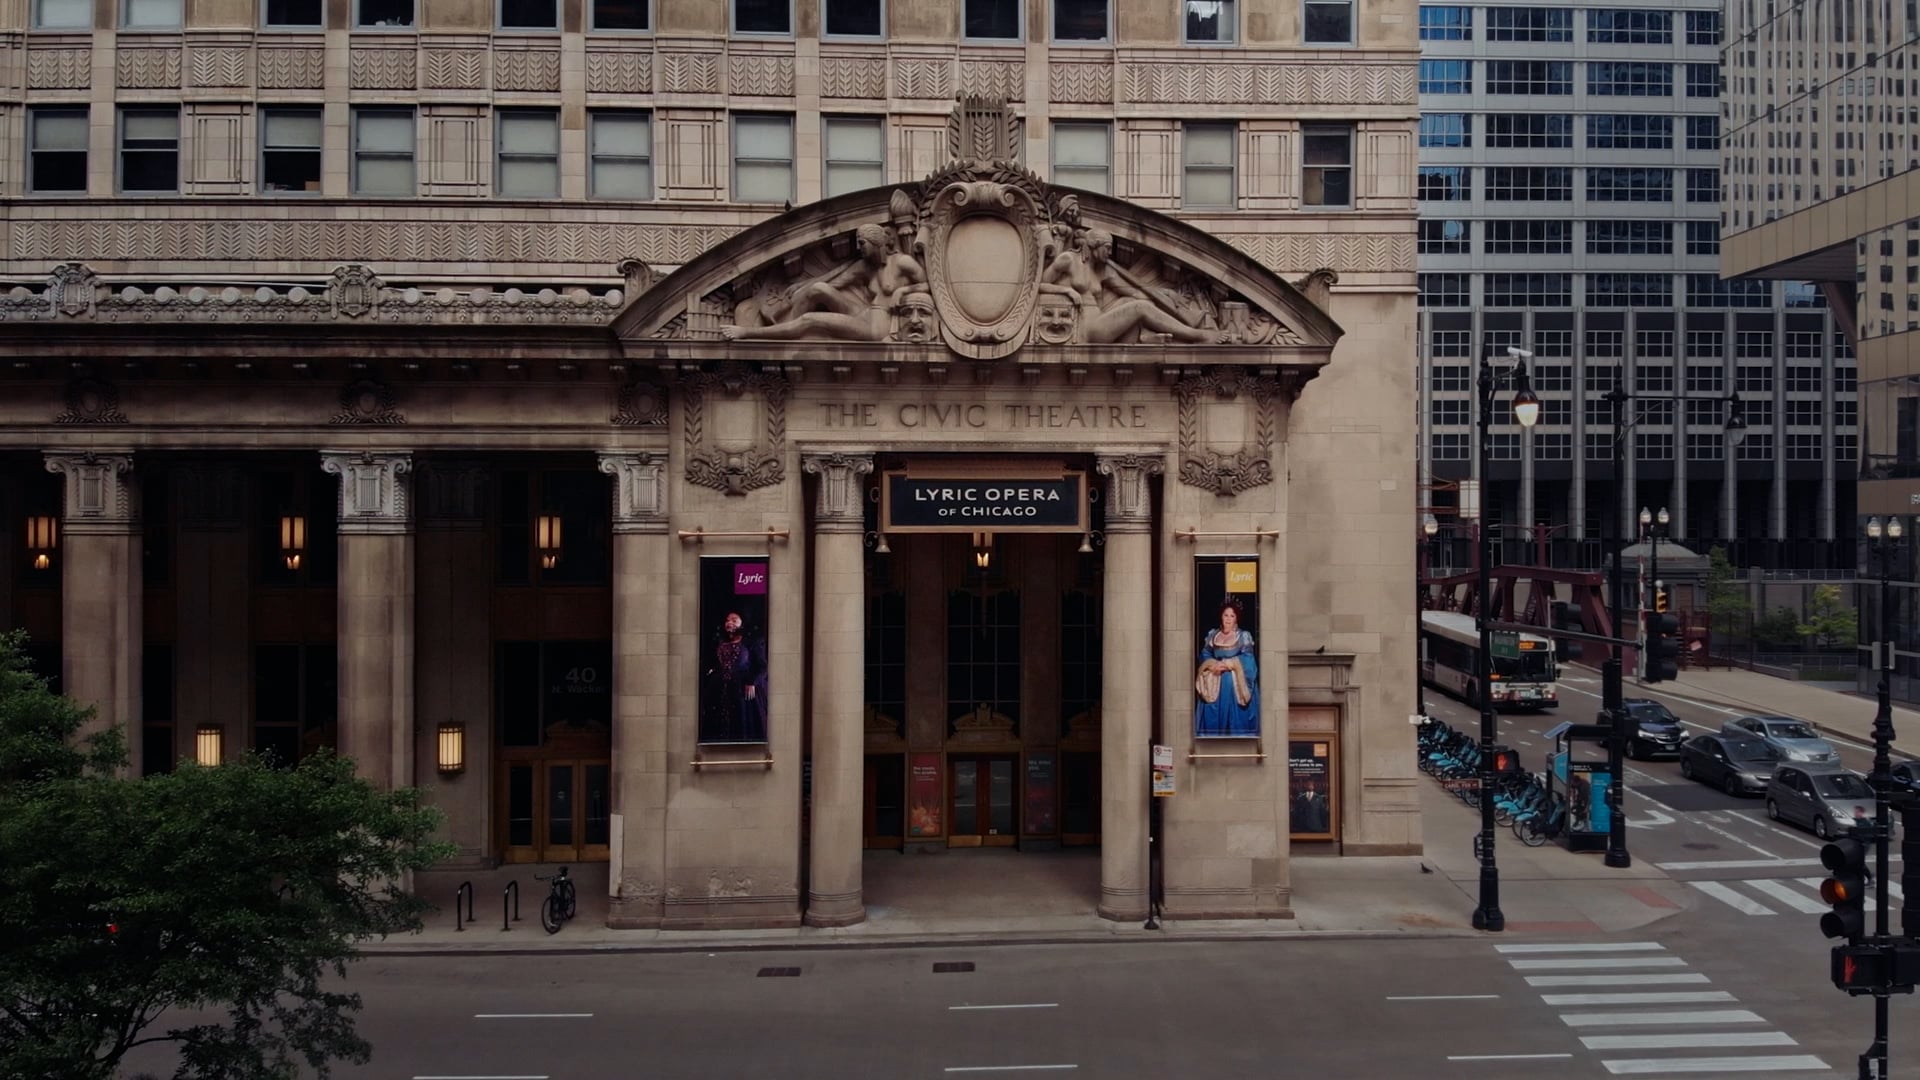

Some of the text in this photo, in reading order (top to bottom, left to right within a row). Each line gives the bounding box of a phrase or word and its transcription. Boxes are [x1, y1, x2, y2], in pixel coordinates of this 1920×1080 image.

[822, 404, 1147, 428] THE CIVIC THEATRE
[915, 488, 1060, 501] LYRIC OPERA
[938, 506, 1037, 517] OF CHICAGO
[738, 573, 764, 585] Lyric
[1230, 571, 1253, 584] Lyric
[564, 667, 597, 683] 40
